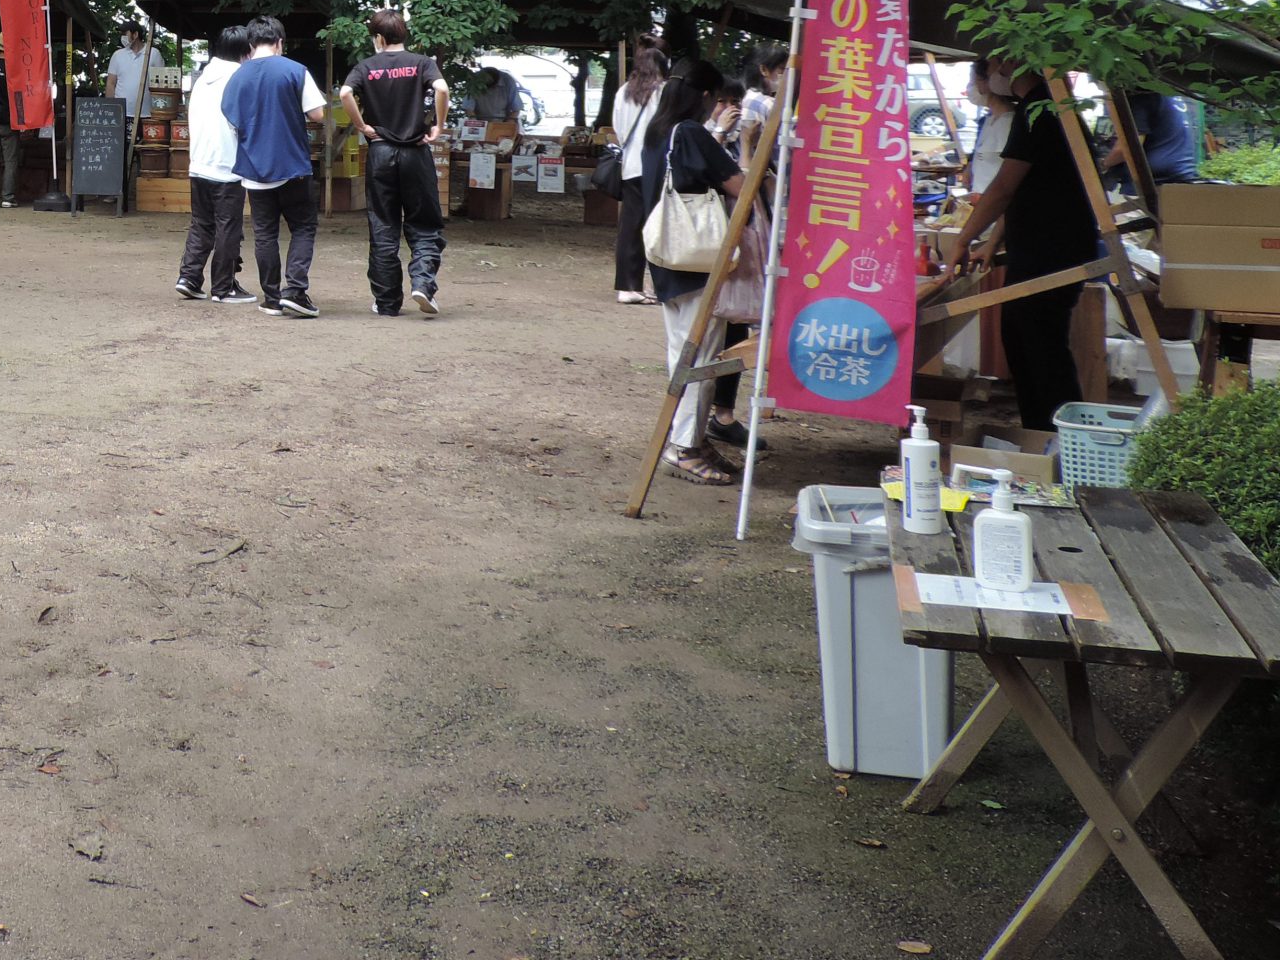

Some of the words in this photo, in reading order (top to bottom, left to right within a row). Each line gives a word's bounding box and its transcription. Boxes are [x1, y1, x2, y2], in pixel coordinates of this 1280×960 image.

[20, 37, 35, 97] NOIR
[386, 66, 418, 79] YONEX
[795, 318, 888, 356] 水出し
[806, 351, 872, 386] 冷茶
